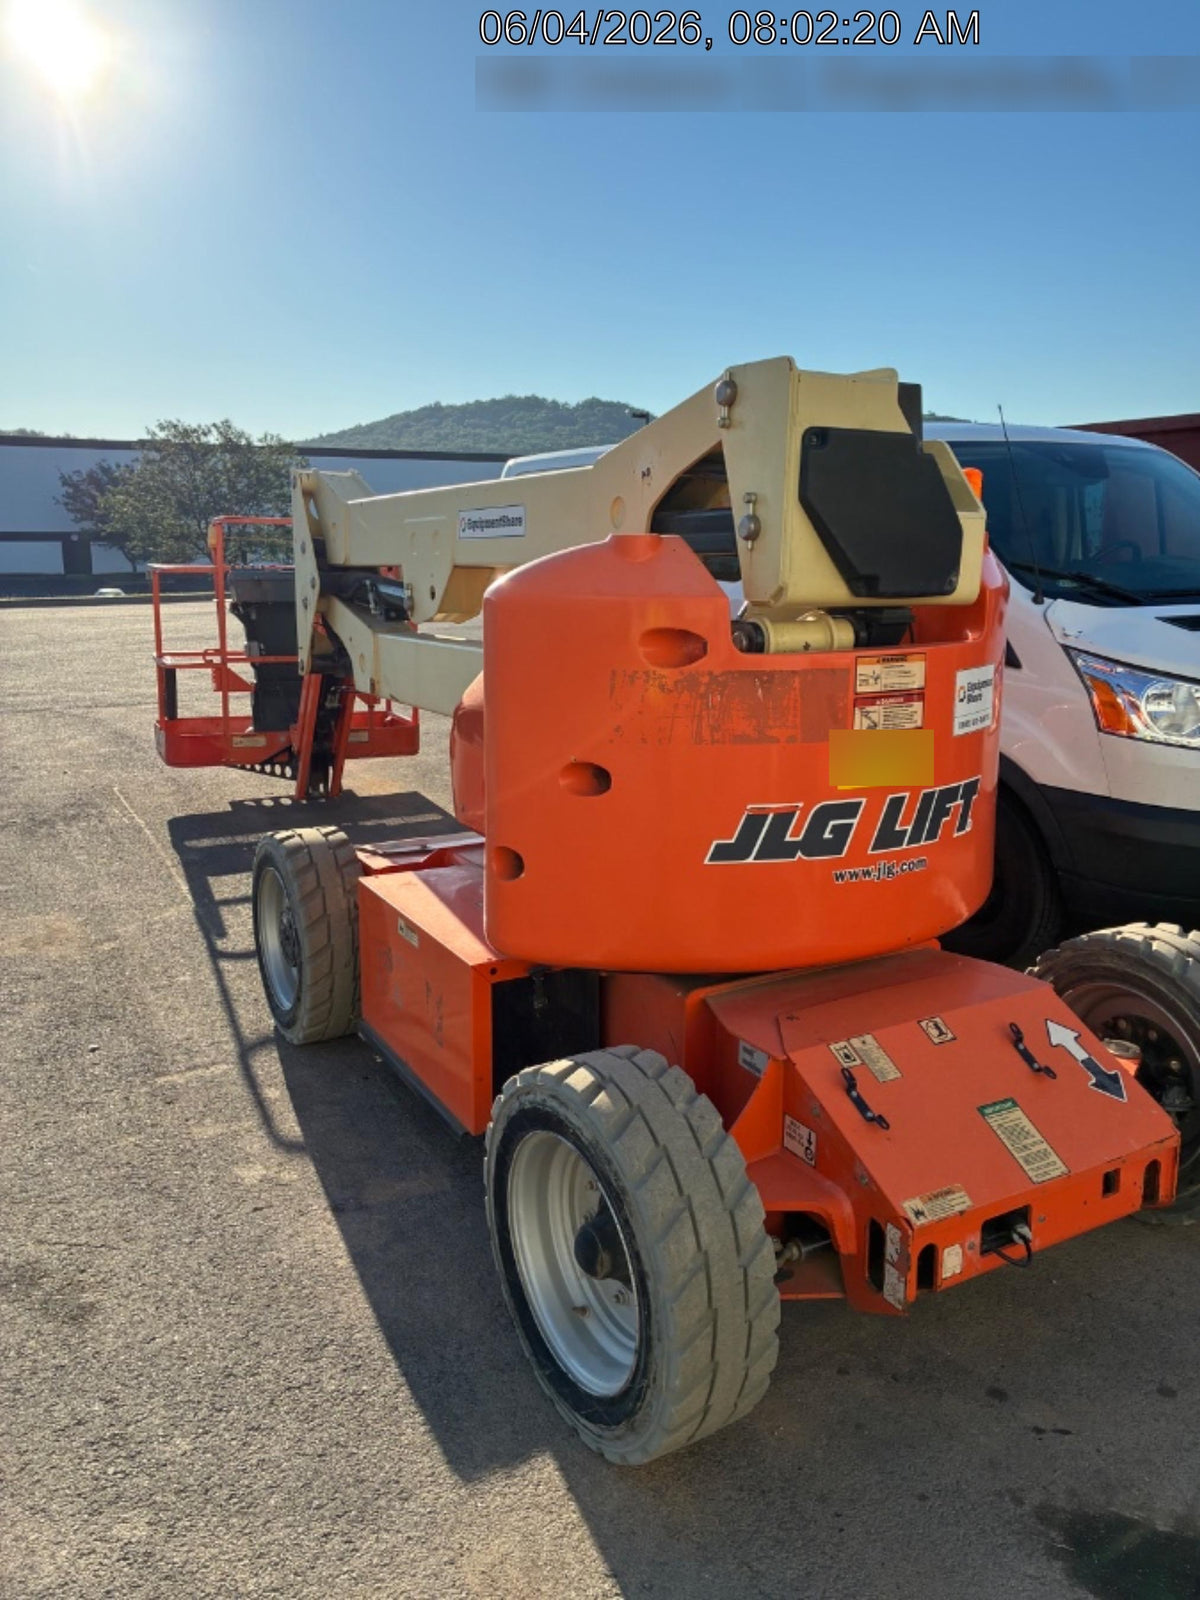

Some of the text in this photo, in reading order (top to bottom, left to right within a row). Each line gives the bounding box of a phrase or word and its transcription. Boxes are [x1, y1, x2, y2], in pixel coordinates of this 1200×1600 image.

[704, 775, 981, 864] JLG LIFT
[833, 857, 928, 883] www.jlg.com
